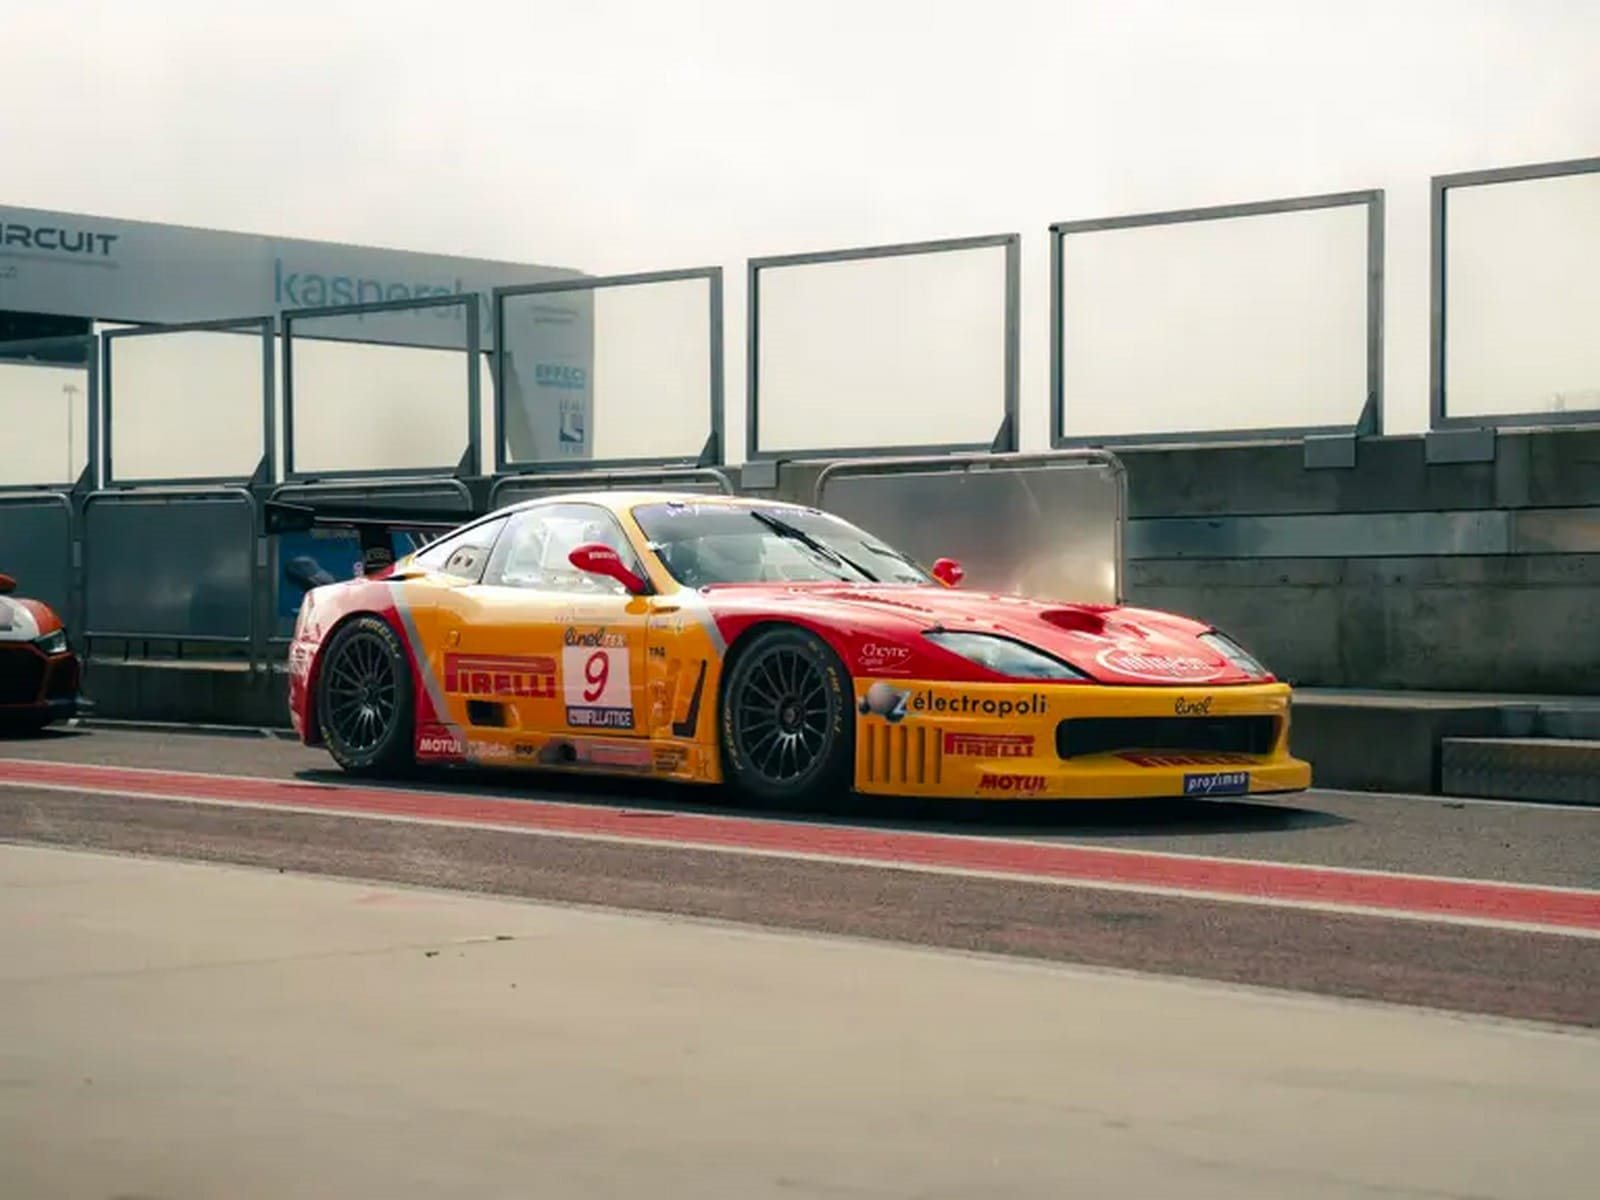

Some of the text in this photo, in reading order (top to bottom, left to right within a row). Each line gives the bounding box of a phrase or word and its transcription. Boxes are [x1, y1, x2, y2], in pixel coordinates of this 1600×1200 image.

[444, 653, 556, 698] PIRELLI
[583, 650, 609, 702] 9
[912, 689, 1047, 717] électropoli
[419, 738, 463, 753] MOTUL
[944, 733, 1035, 757] PIRELLI
[979, 774, 1047, 792] MOTUL
[1187, 773, 1246, 793] proximus
